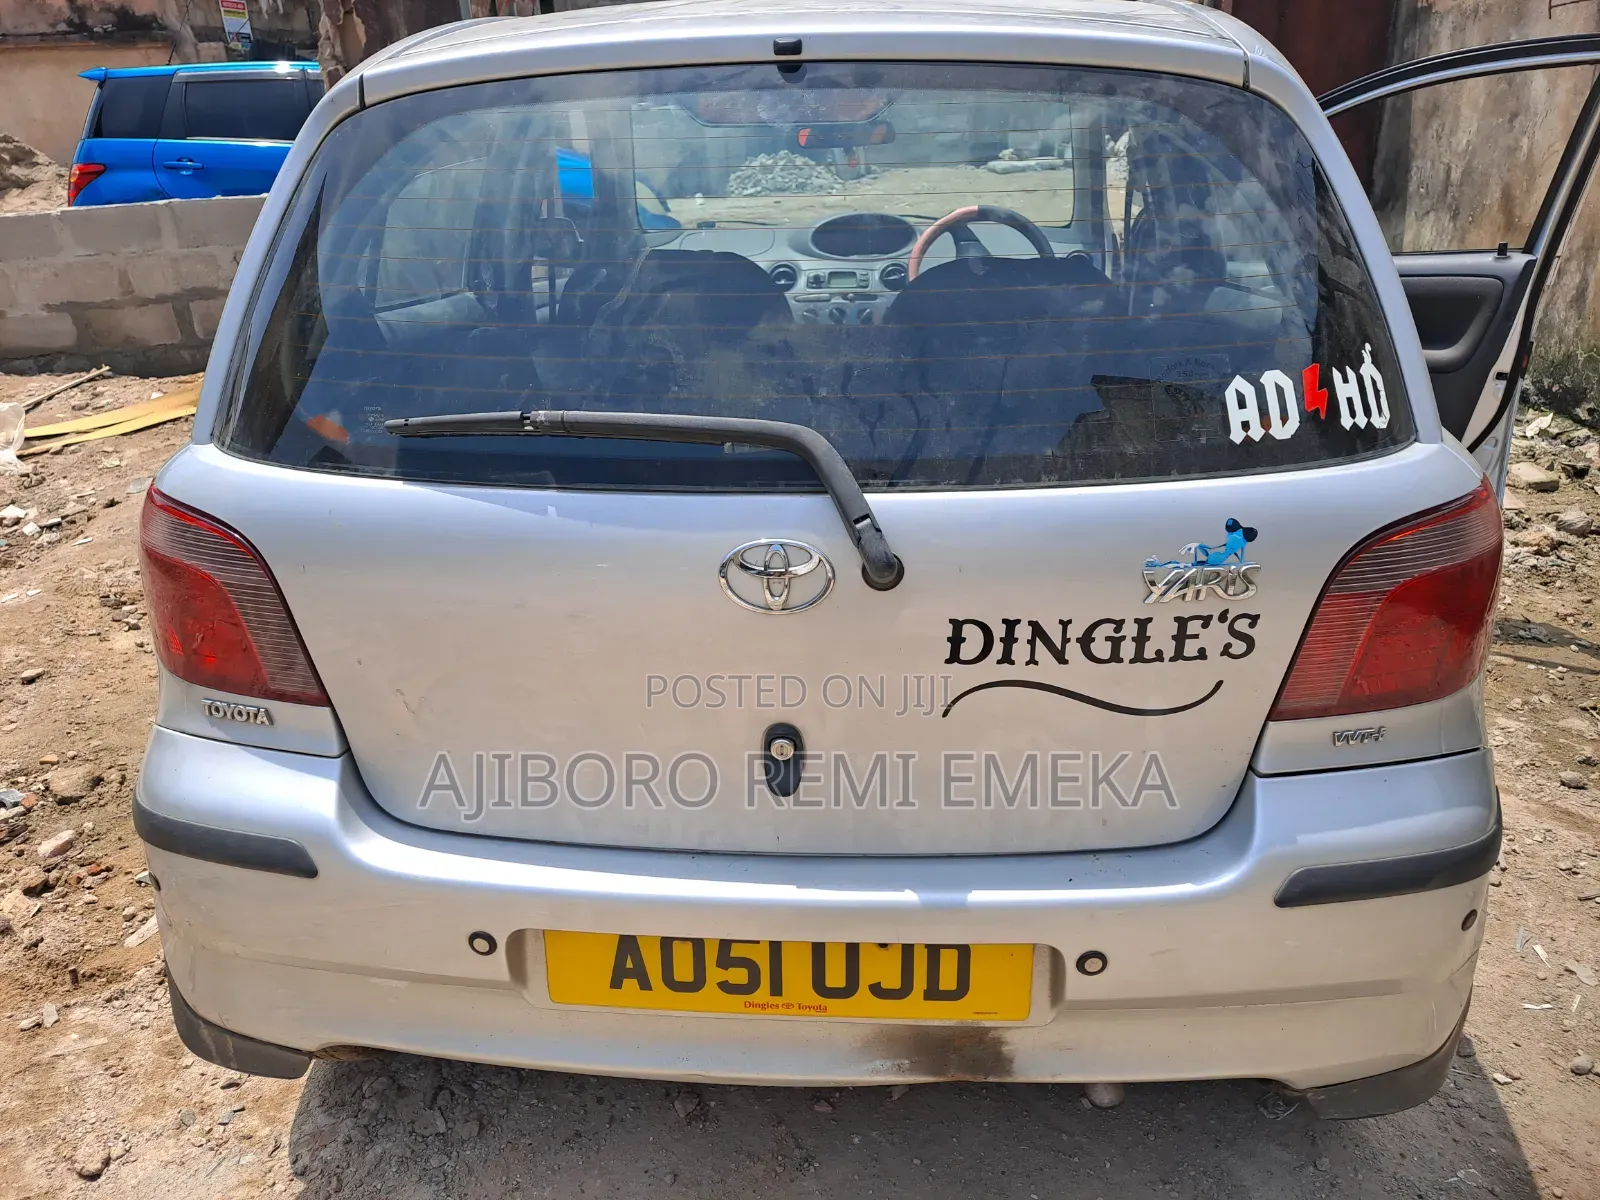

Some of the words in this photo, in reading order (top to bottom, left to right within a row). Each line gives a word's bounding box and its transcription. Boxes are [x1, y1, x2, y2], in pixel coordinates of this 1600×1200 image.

[944, 609, 1261, 666] DINGLE'S
[201, 698, 273, 726] TOYOTA
[810, 941, 972, 1002] UJD
[743, 1000, 780, 1011] Dingles
[797, 1002, 828, 1013] Toyota
